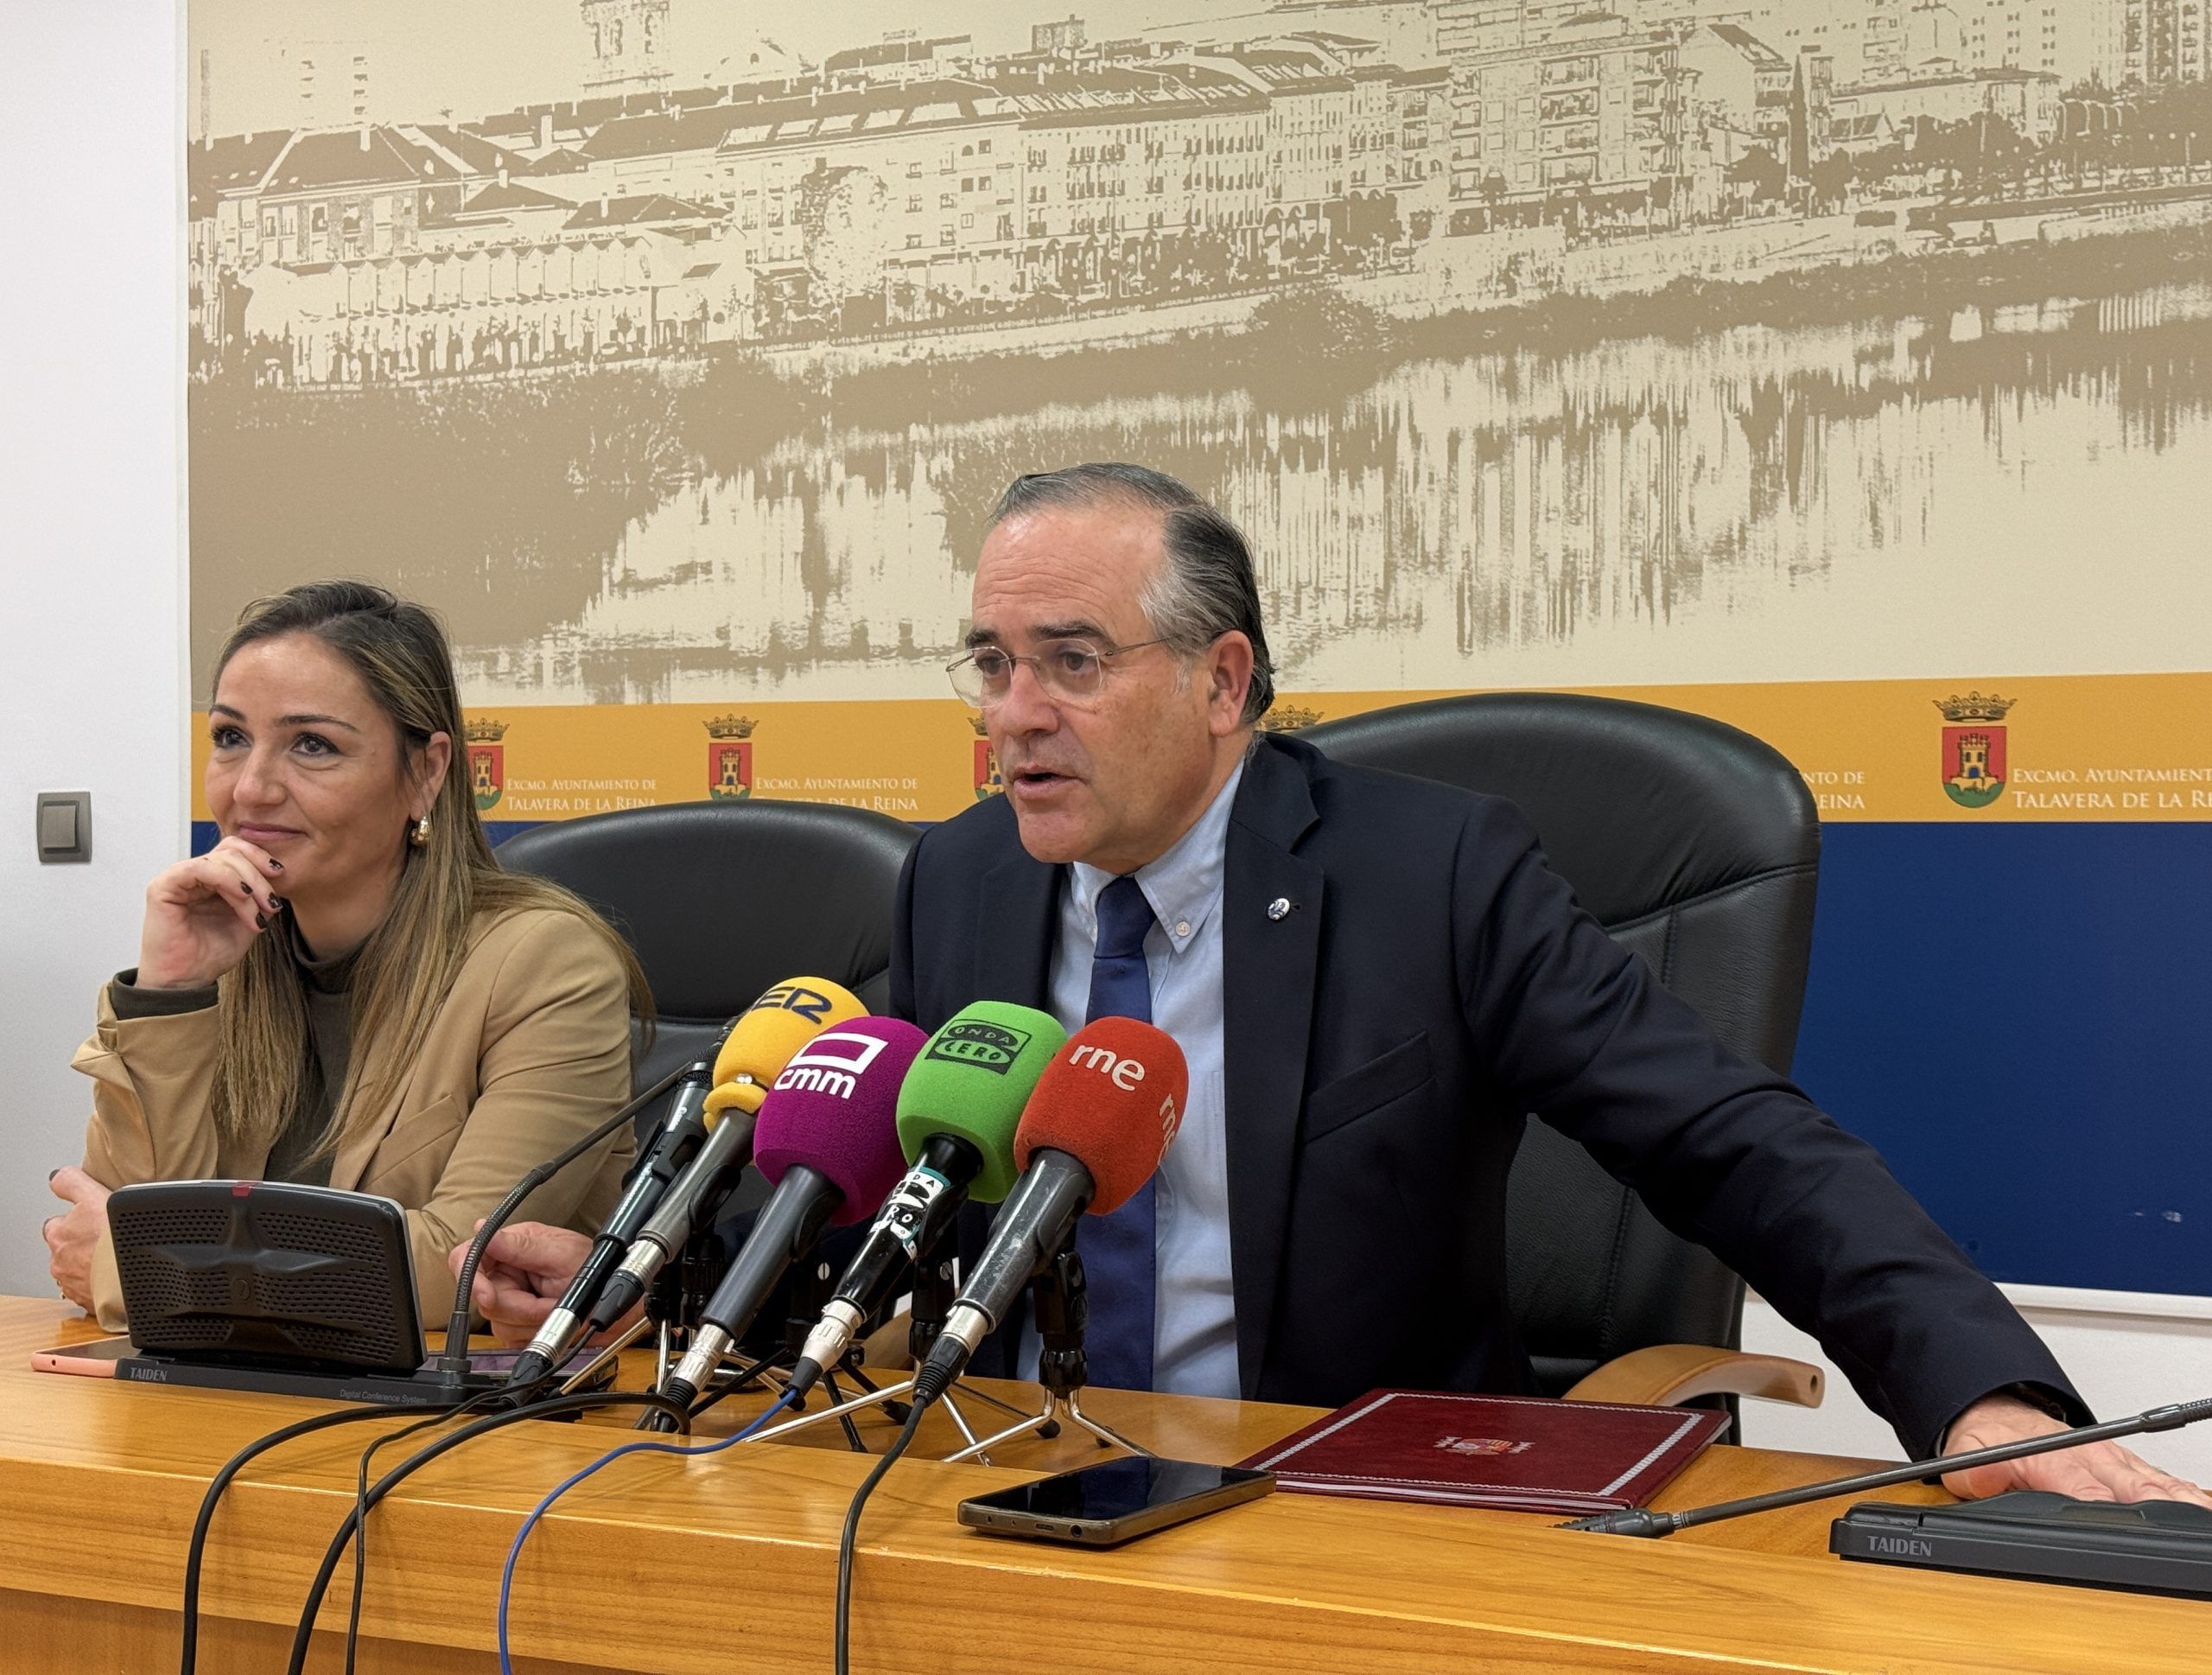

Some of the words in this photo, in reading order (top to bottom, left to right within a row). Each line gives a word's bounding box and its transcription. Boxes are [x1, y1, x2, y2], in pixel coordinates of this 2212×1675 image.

[1843, 771, 1865, 784] DE
[2085, 767, 2212, 782] AYUNTAMIENT
[551, 779, 639, 790] AYUNTAMIENTO
[642, 780, 657, 790] DE
[804, 778, 899, 789] AYUNTAMIENTO
[902, 779, 918, 789] DE
[507, 796, 569, 811] TALAVERA
[574, 798, 591, 811] DE
[596, 798, 611, 811] LA
[874, 796, 918, 810] REINA
[1820, 794, 1865, 809] EINA
[2012, 790, 2114, 809] TALAVERA
[2122, 792, 2150, 808] DE
[2158, 793, 2183, 808] LA
[751, 986, 832, 1025] ER
[954, 1026, 1010, 1044] ONDA
[944, 1040, 1002, 1060] CERO
[1068, 1044, 1146, 1092] rne
[773, 1067, 856, 1100] cmm
[130, 1366, 168, 1382] TAIDEN
[1866, 1535, 1932, 1557] TAIDEN
